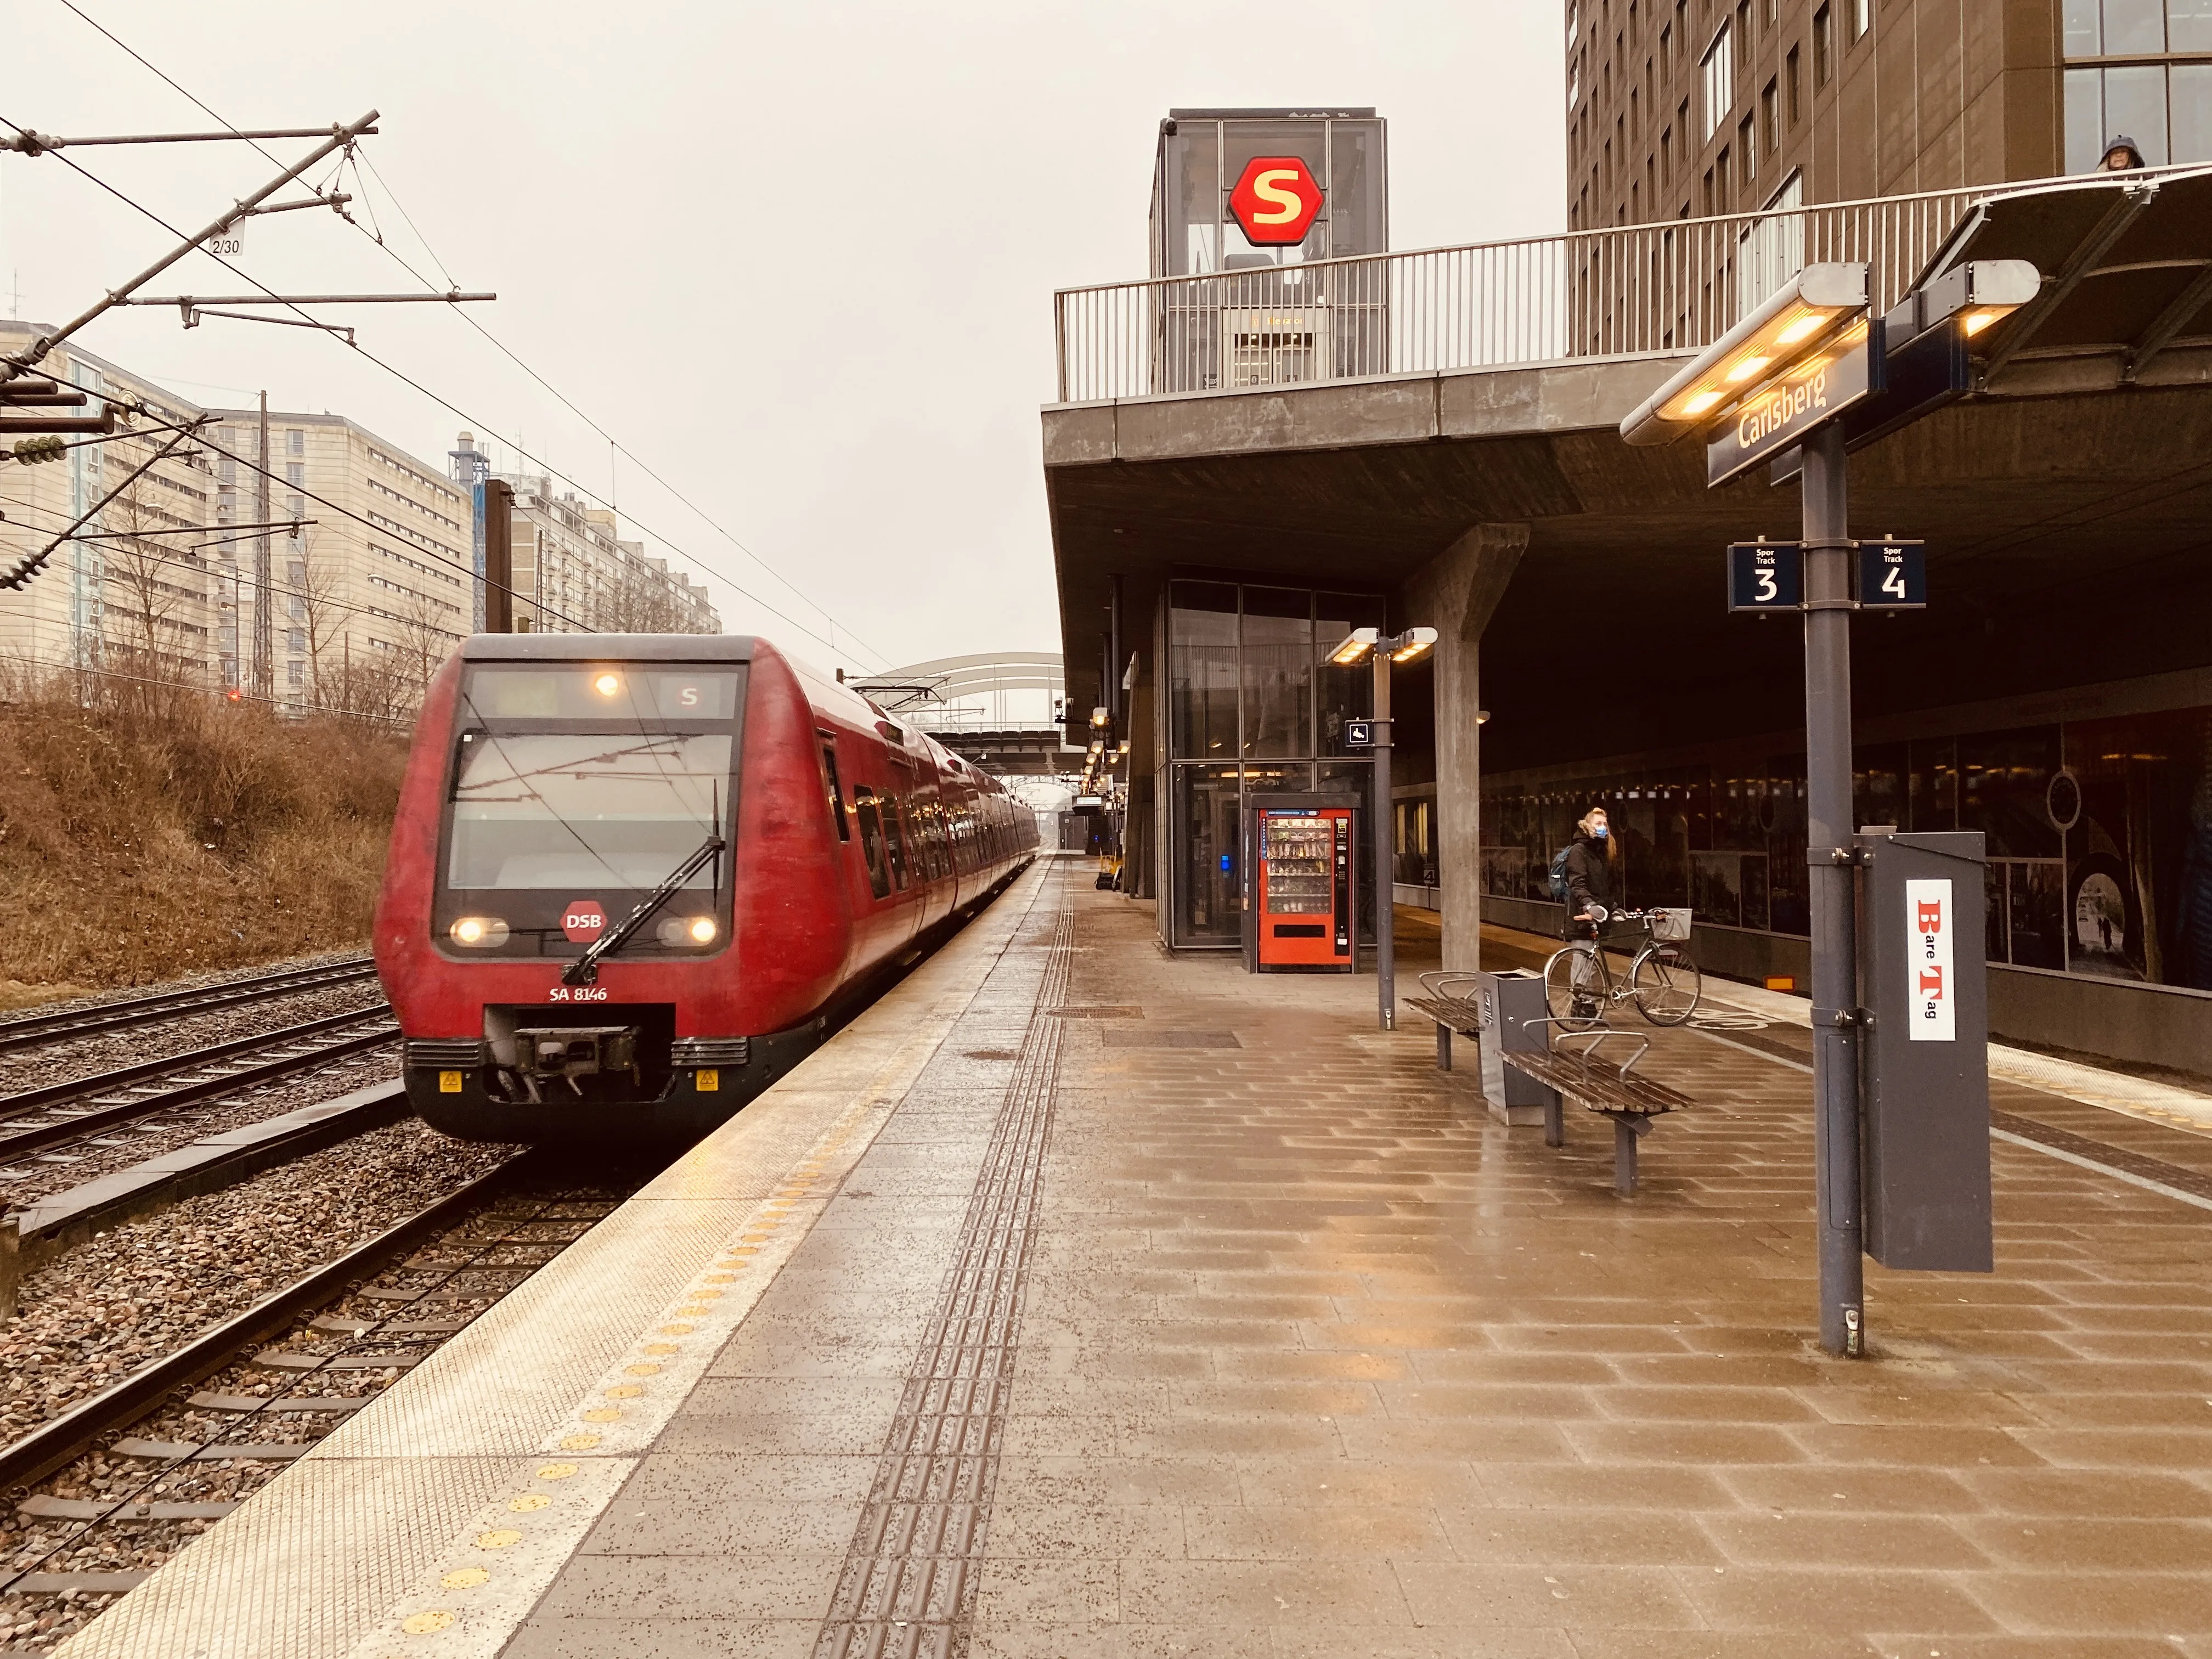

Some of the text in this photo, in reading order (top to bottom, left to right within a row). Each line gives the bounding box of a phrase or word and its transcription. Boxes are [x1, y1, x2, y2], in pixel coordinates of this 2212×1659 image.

[1254, 169, 1302, 224] S
[213, 240, 239, 253] 2/30
[1738, 366, 1827, 449] Carlsberg
[1755, 568, 1777, 601] 3
[1882, 567, 1905, 599] 4
[681, 687, 697, 705] S
[1424, 871, 1435, 882] 4
[567, 915, 601, 928] DSB
[1918, 899, 1943, 1019] Bare Tag
[550, 988, 607, 1001] SA 8146
